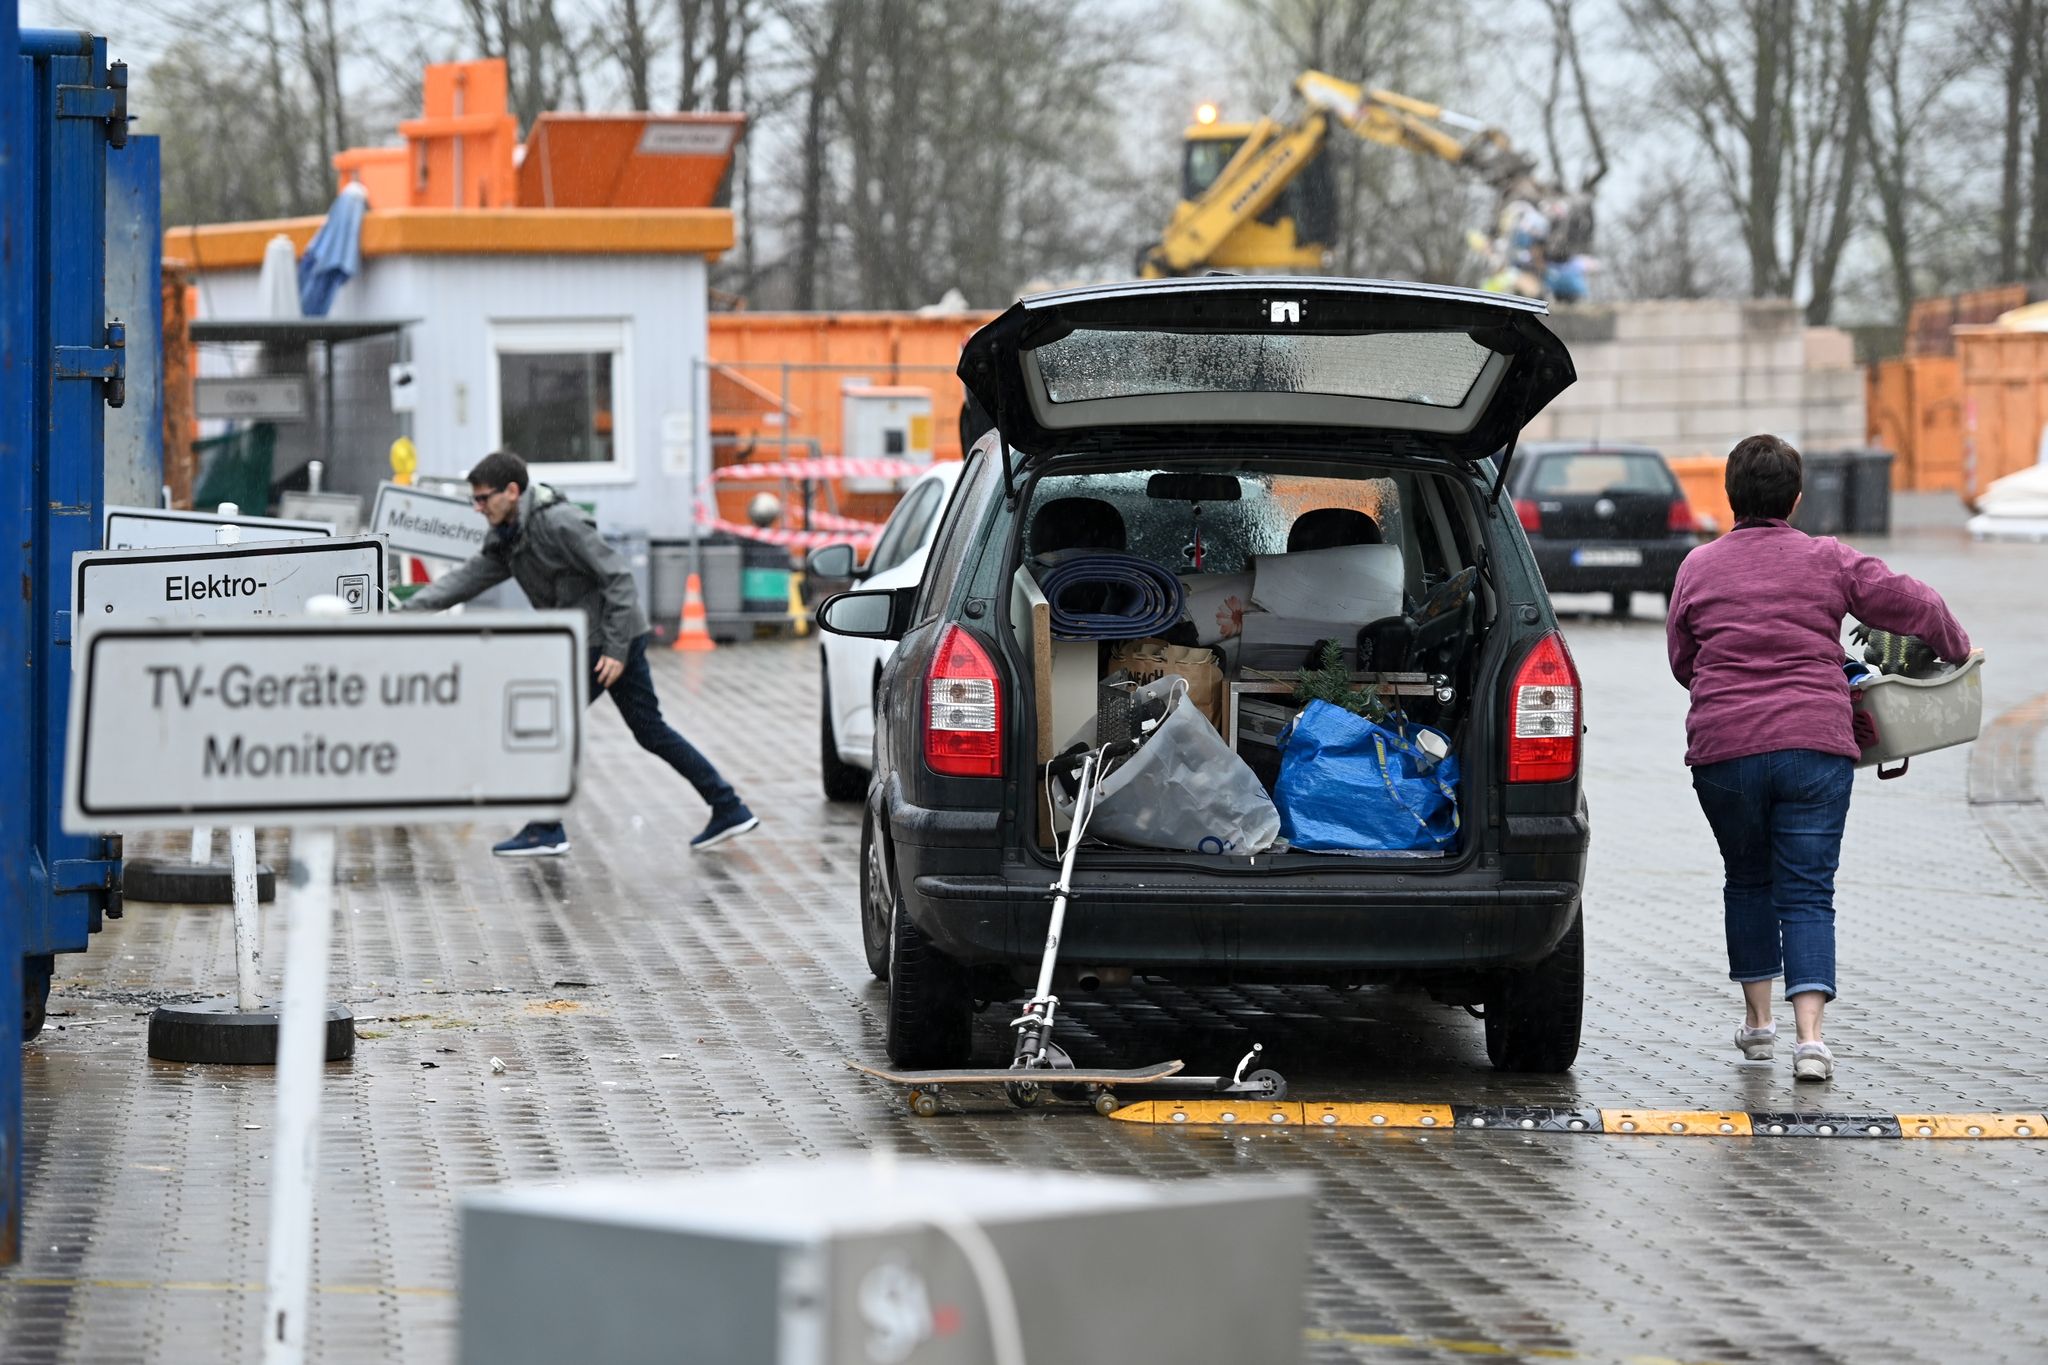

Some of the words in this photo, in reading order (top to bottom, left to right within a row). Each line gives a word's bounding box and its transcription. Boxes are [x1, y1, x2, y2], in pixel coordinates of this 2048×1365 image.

[388, 509, 484, 544] Metallschro
[166, 574, 267, 601] Elektro-
[146, 664, 366, 708] TV-Geräte
[380, 662, 461, 706] und
[202, 733, 398, 778] Monitore
